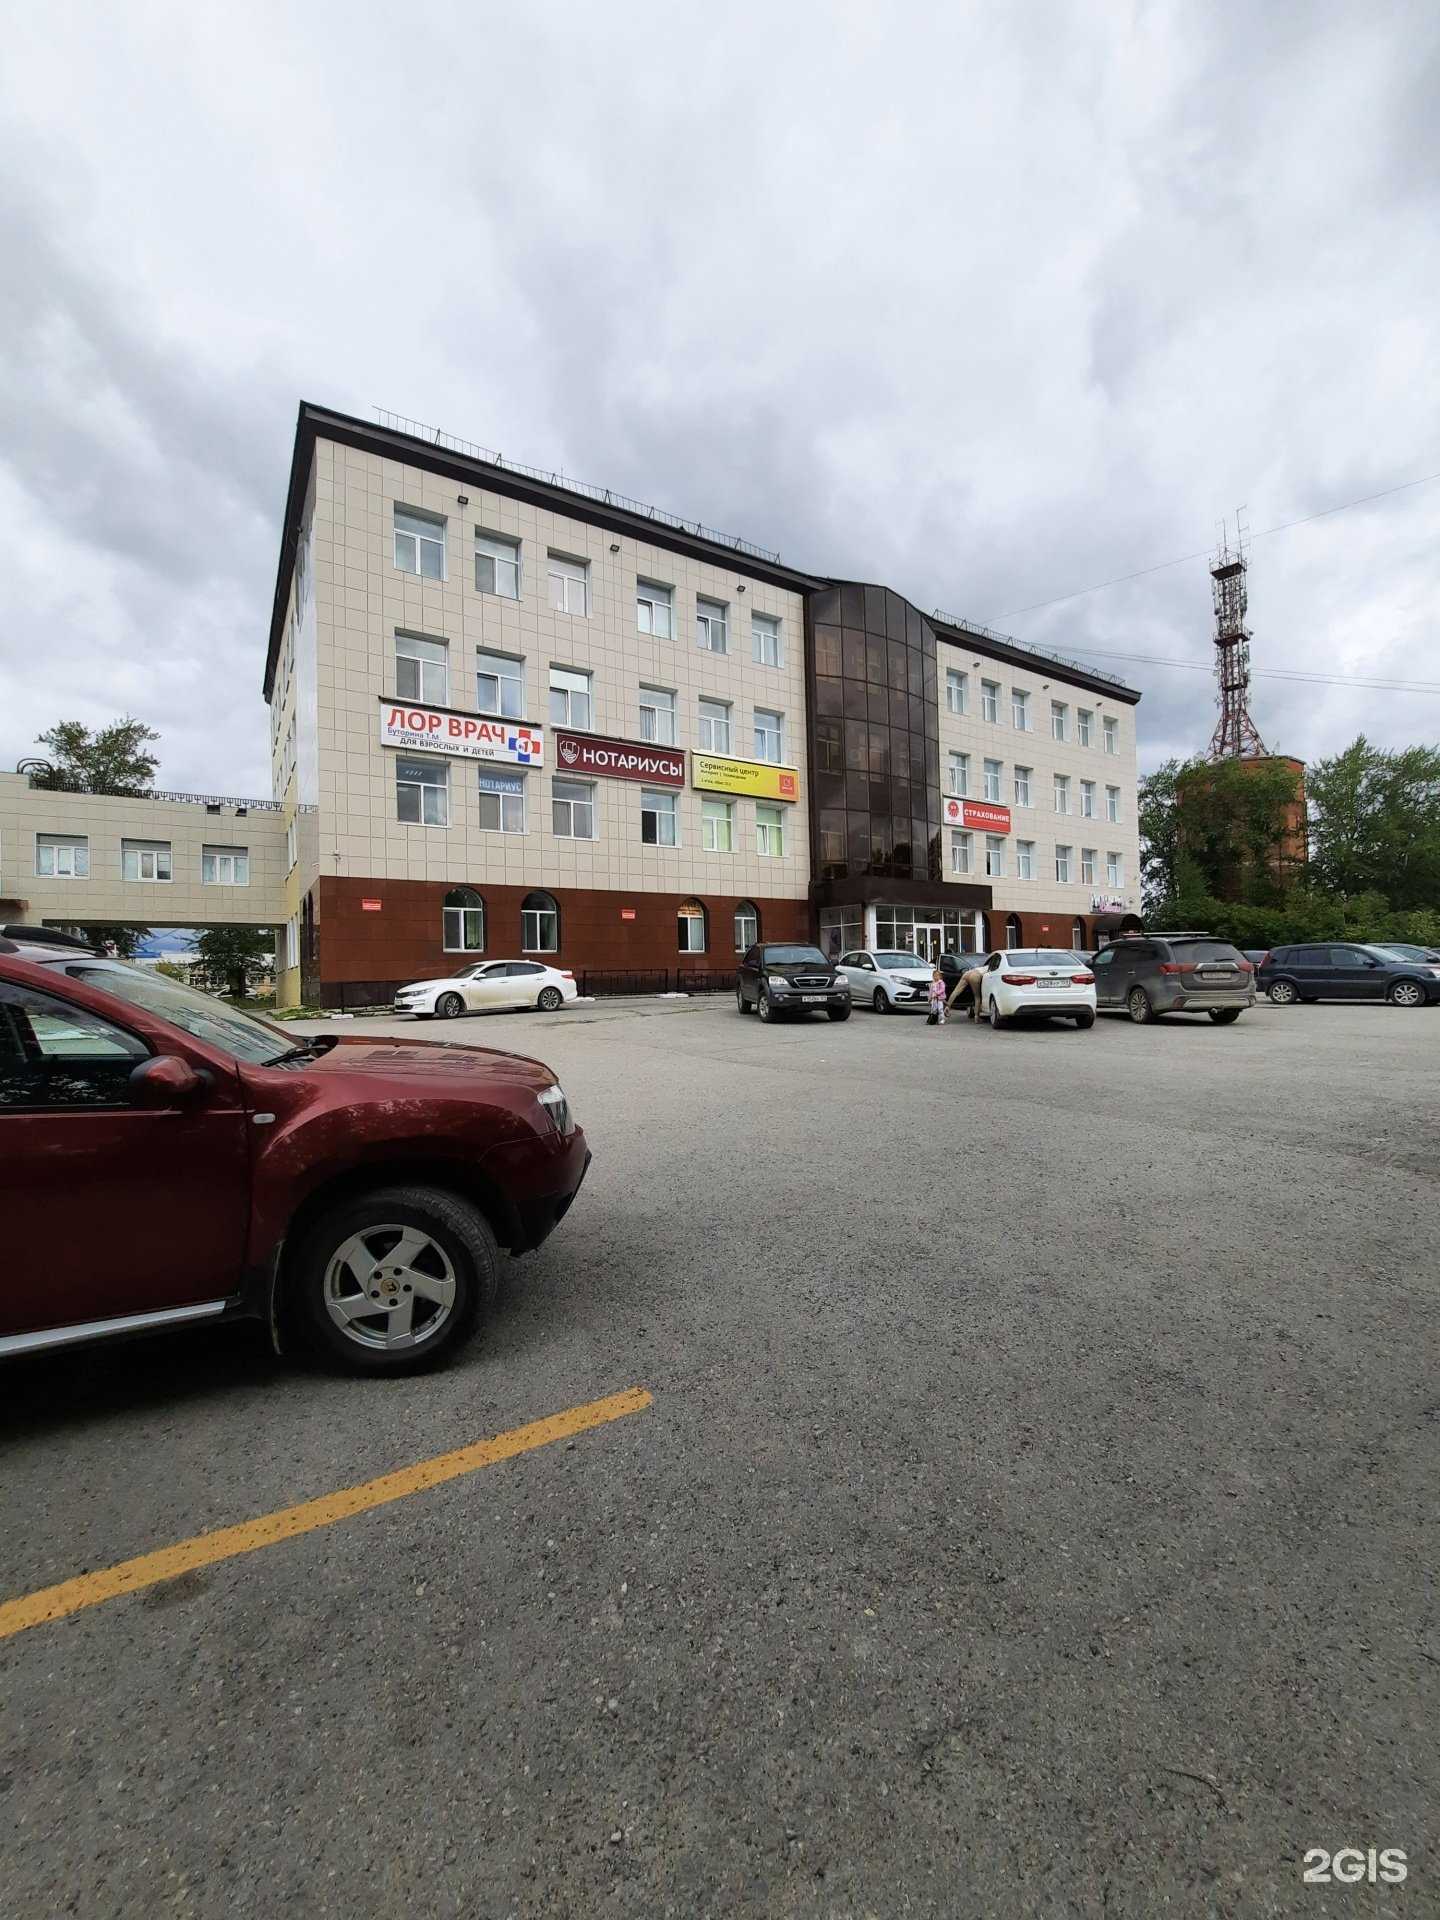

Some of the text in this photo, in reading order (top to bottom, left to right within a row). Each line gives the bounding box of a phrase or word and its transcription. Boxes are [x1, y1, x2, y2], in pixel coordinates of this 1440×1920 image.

[387, 709, 505, 744] ЛОР ВРАЧ
[583, 748, 682, 776] НОТАРИУСЫ
[700, 761, 738, 773] Сервисный
[740, 768, 760, 777] центр
[480, 778, 521, 791] НОТАРИУС
[964, 809, 1010, 822] СТРАХОВАНИЕ
